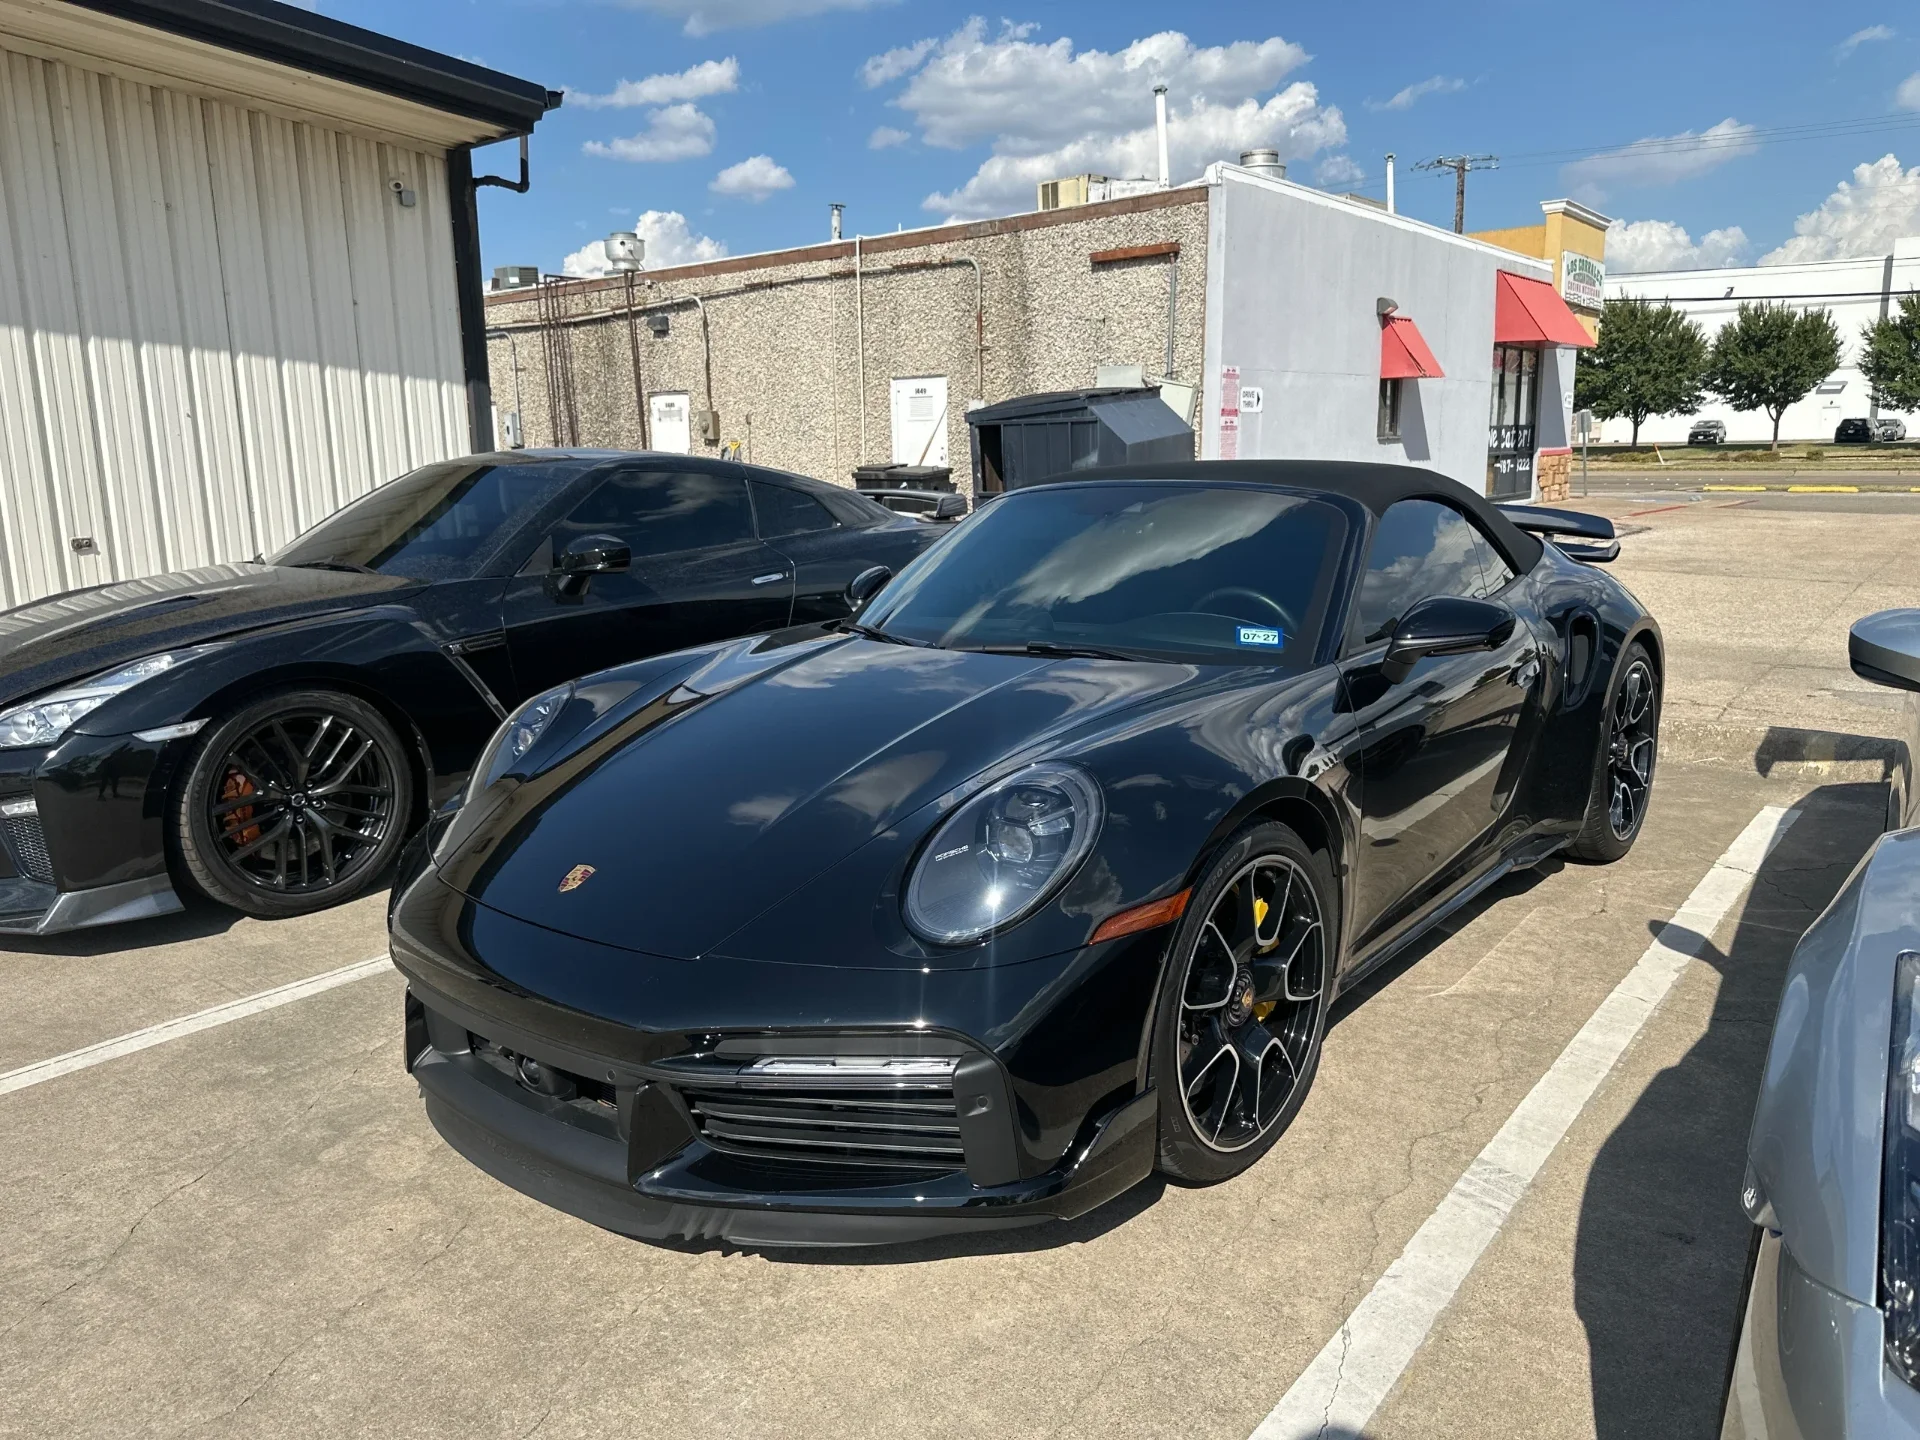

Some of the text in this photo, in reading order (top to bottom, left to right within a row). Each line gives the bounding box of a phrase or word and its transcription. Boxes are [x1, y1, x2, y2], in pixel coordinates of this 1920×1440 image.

[1567, 259, 1577, 276] LOS
[1578, 258, 1602, 287] CORRALES
[1243, 390, 1255, 399] DRIVE
[1243, 400, 1254, 408] THRU
